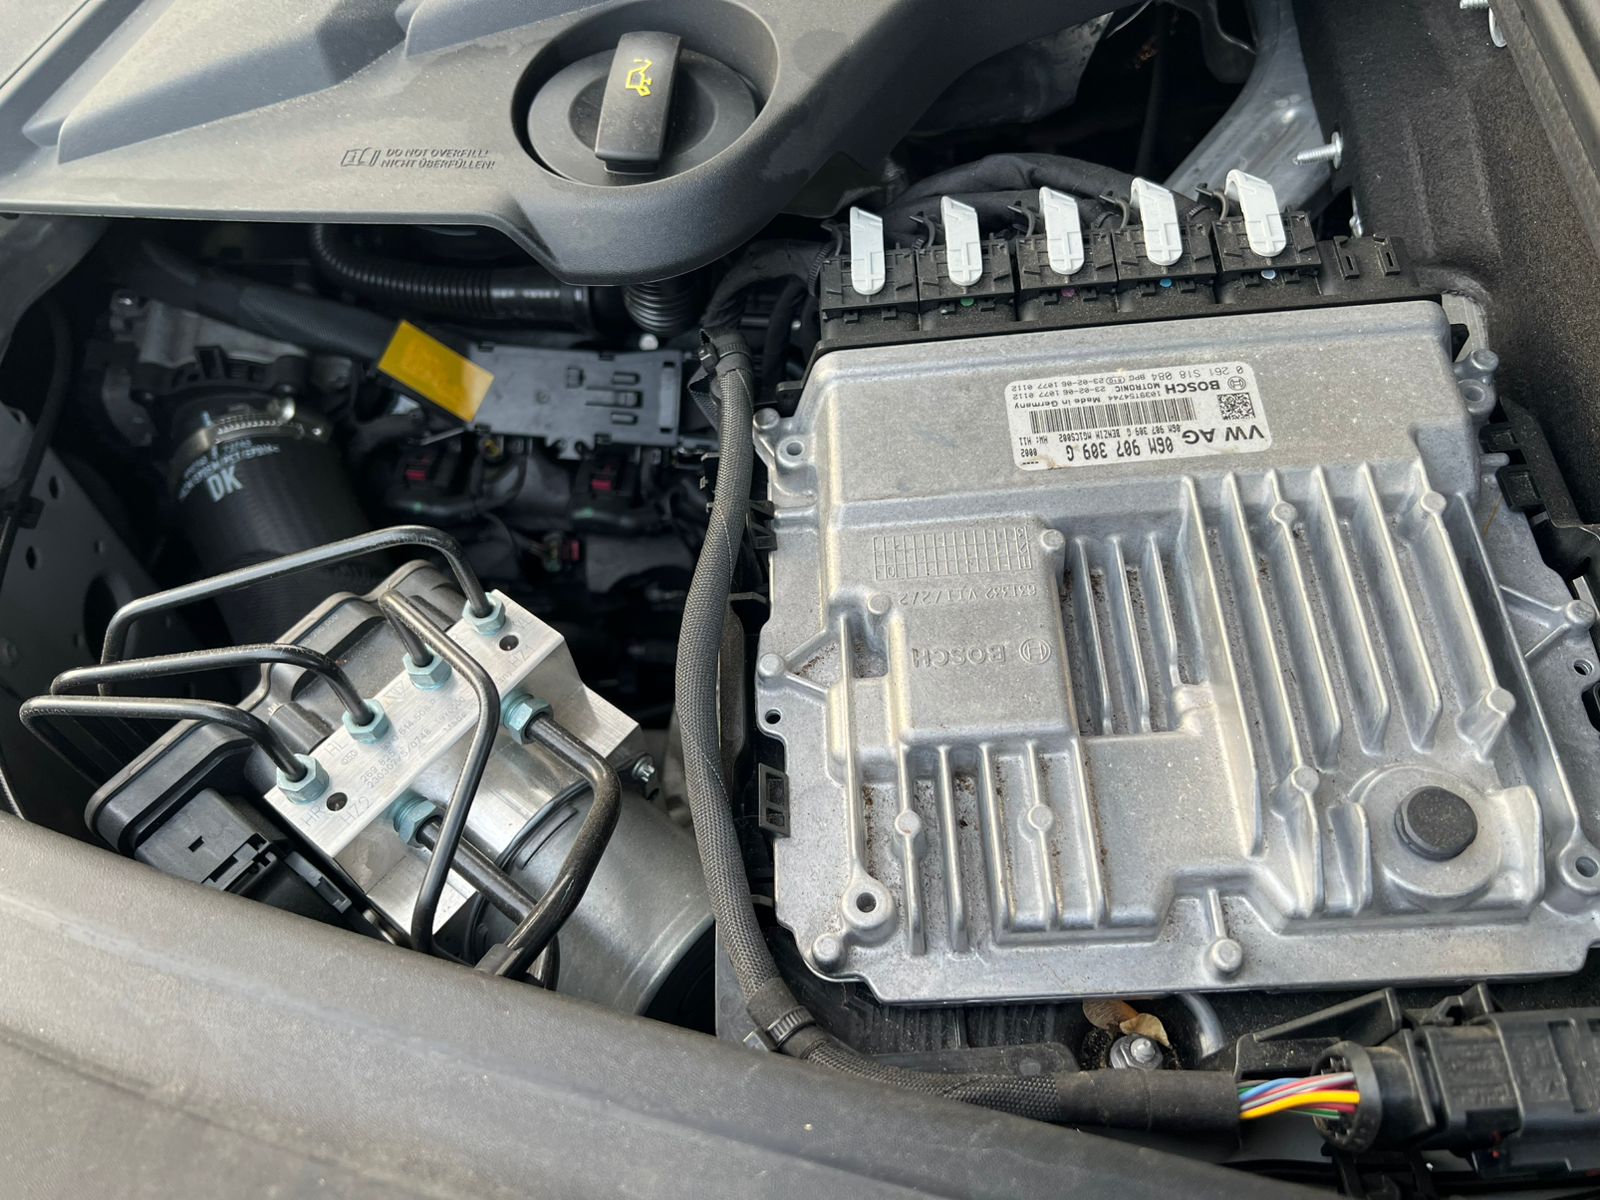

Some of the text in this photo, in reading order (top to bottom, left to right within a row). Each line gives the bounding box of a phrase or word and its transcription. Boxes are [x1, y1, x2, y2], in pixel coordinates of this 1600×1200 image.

[386, 148, 489, 158] DO NOT OVERFILL!
[380, 159, 495, 169] NICHT ÜBERFÜLLEN!
[1151, 372, 1171, 382] 084
[1208, 367, 1228, 378] 261
[1011, 378, 1104, 392] 23-02-06 1077 0112
[1115, 382, 1160, 392] MOTRONIC
[1165, 380, 1220, 394] BOSCH
[1013, 386, 1106, 400] 23-02-06 1077 0112
[1014, 399, 1058, 410] Germany
[1075, 396, 1101, 405] Made
[1181, 424, 1264, 445] VW AG
[1065, 436, 1174, 461] 06M 907 309 G
[206, 465, 243, 502] DK
[911, 645, 1006, 668] BOSCH
